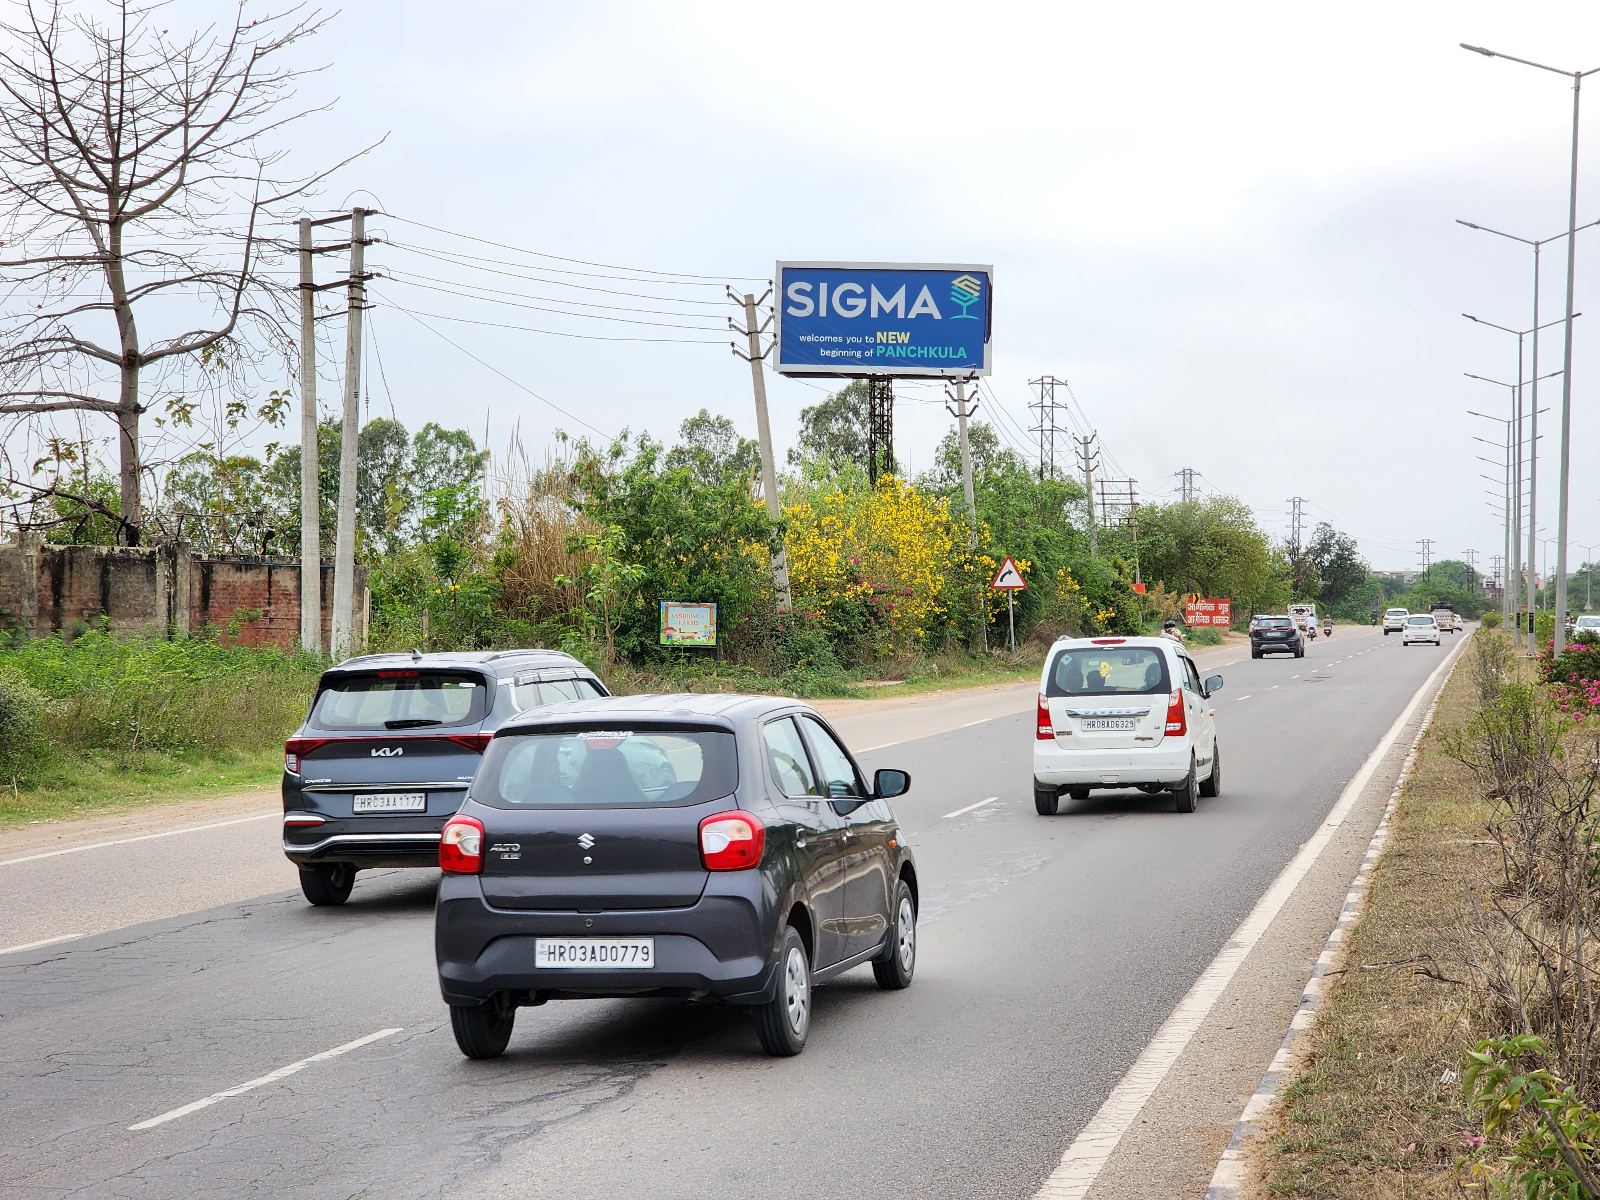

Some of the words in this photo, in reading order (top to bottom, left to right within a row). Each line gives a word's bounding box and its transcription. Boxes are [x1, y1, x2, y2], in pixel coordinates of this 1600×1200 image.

[786, 281, 943, 320] SIGMA
[799, 333, 843, 343] welcomes
[846, 335, 863, 345] you
[865, 334, 875, 344] to
[876, 331, 910, 344] NEW
[820, 347, 862, 359] beginning
[864, 348, 875, 357] of
[876, 345, 968, 359] PANCHKULA
[1086, 719, 1134, 729] HR08AD6329
[371, 747, 404, 757] KIA
[360, 795, 424, 809] HR03AA1177
[547, 944, 650, 962] HR03AD0779
